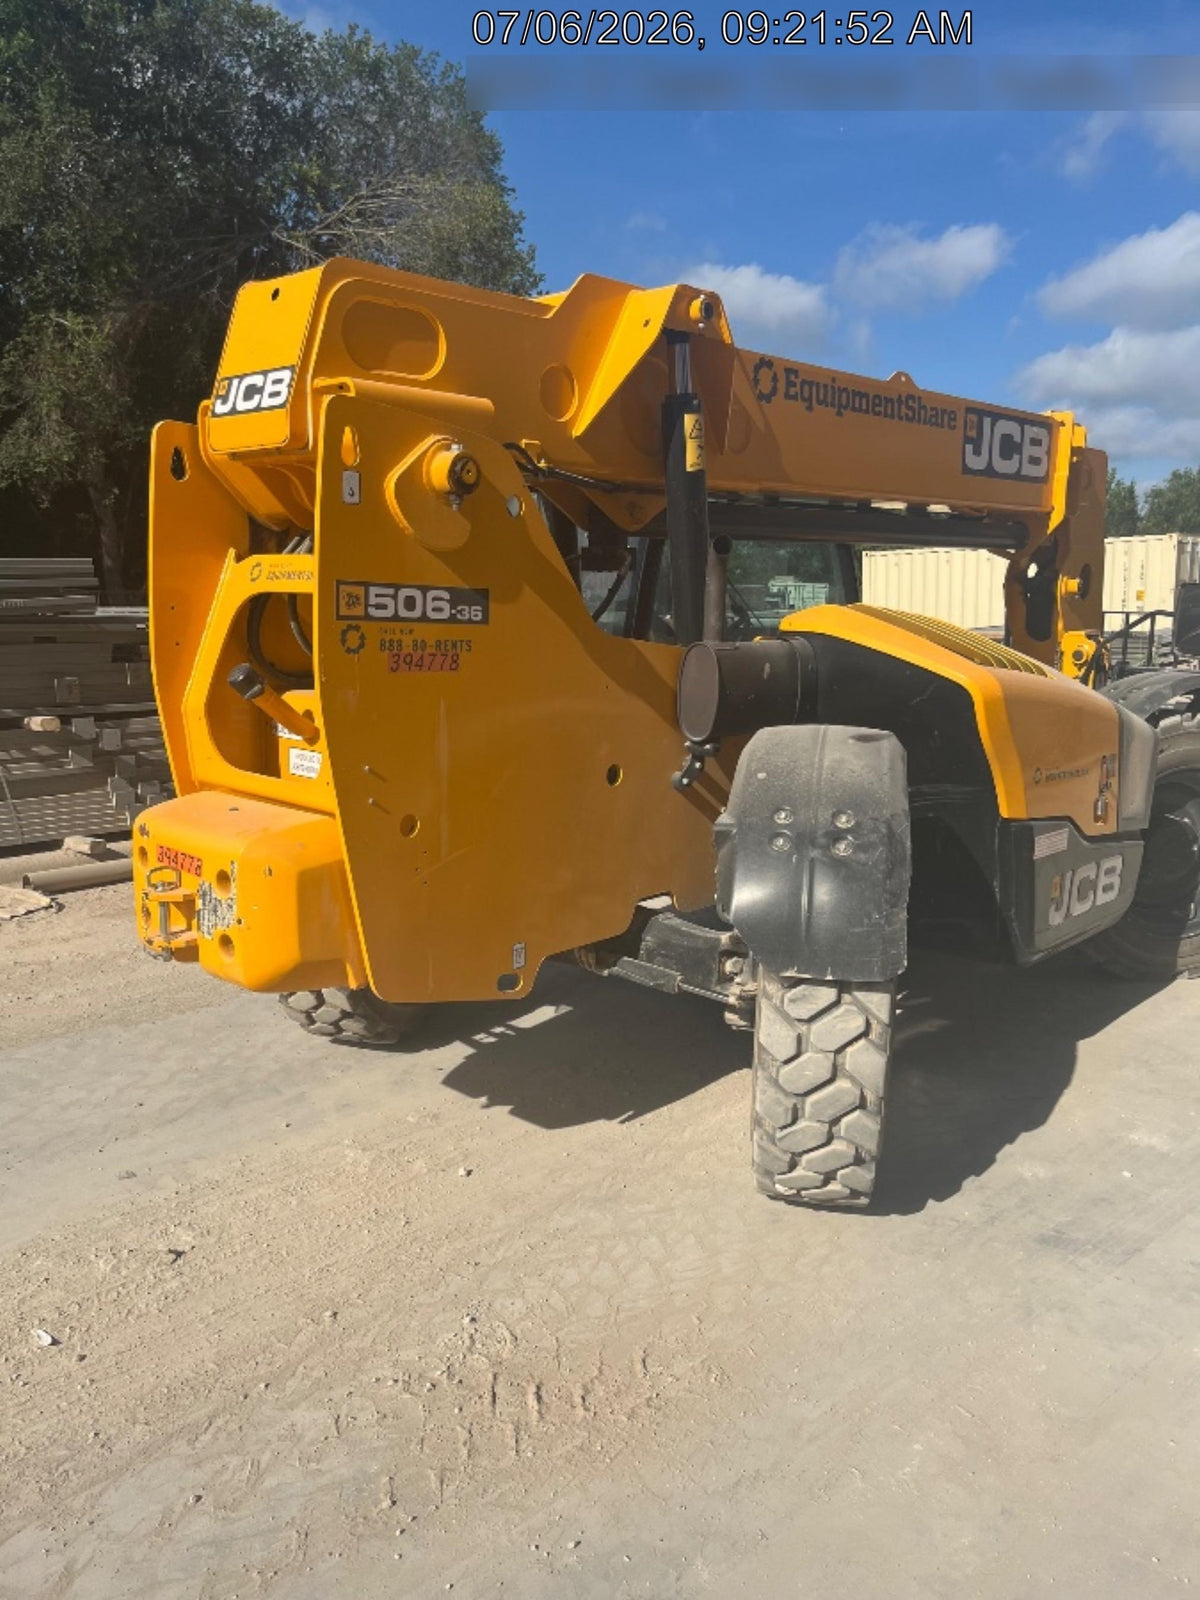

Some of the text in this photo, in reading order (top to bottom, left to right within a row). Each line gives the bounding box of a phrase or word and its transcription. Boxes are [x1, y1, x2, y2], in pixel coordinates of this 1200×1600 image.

[214, 368, 293, 415] JCB
[783, 367, 958, 431] EquipmentShare
[964, 416, 1050, 478] JCB
[389, 652, 461, 673] 394778
[157, 845, 203, 877] 394778
[1048, 854, 1124, 926] JCB
